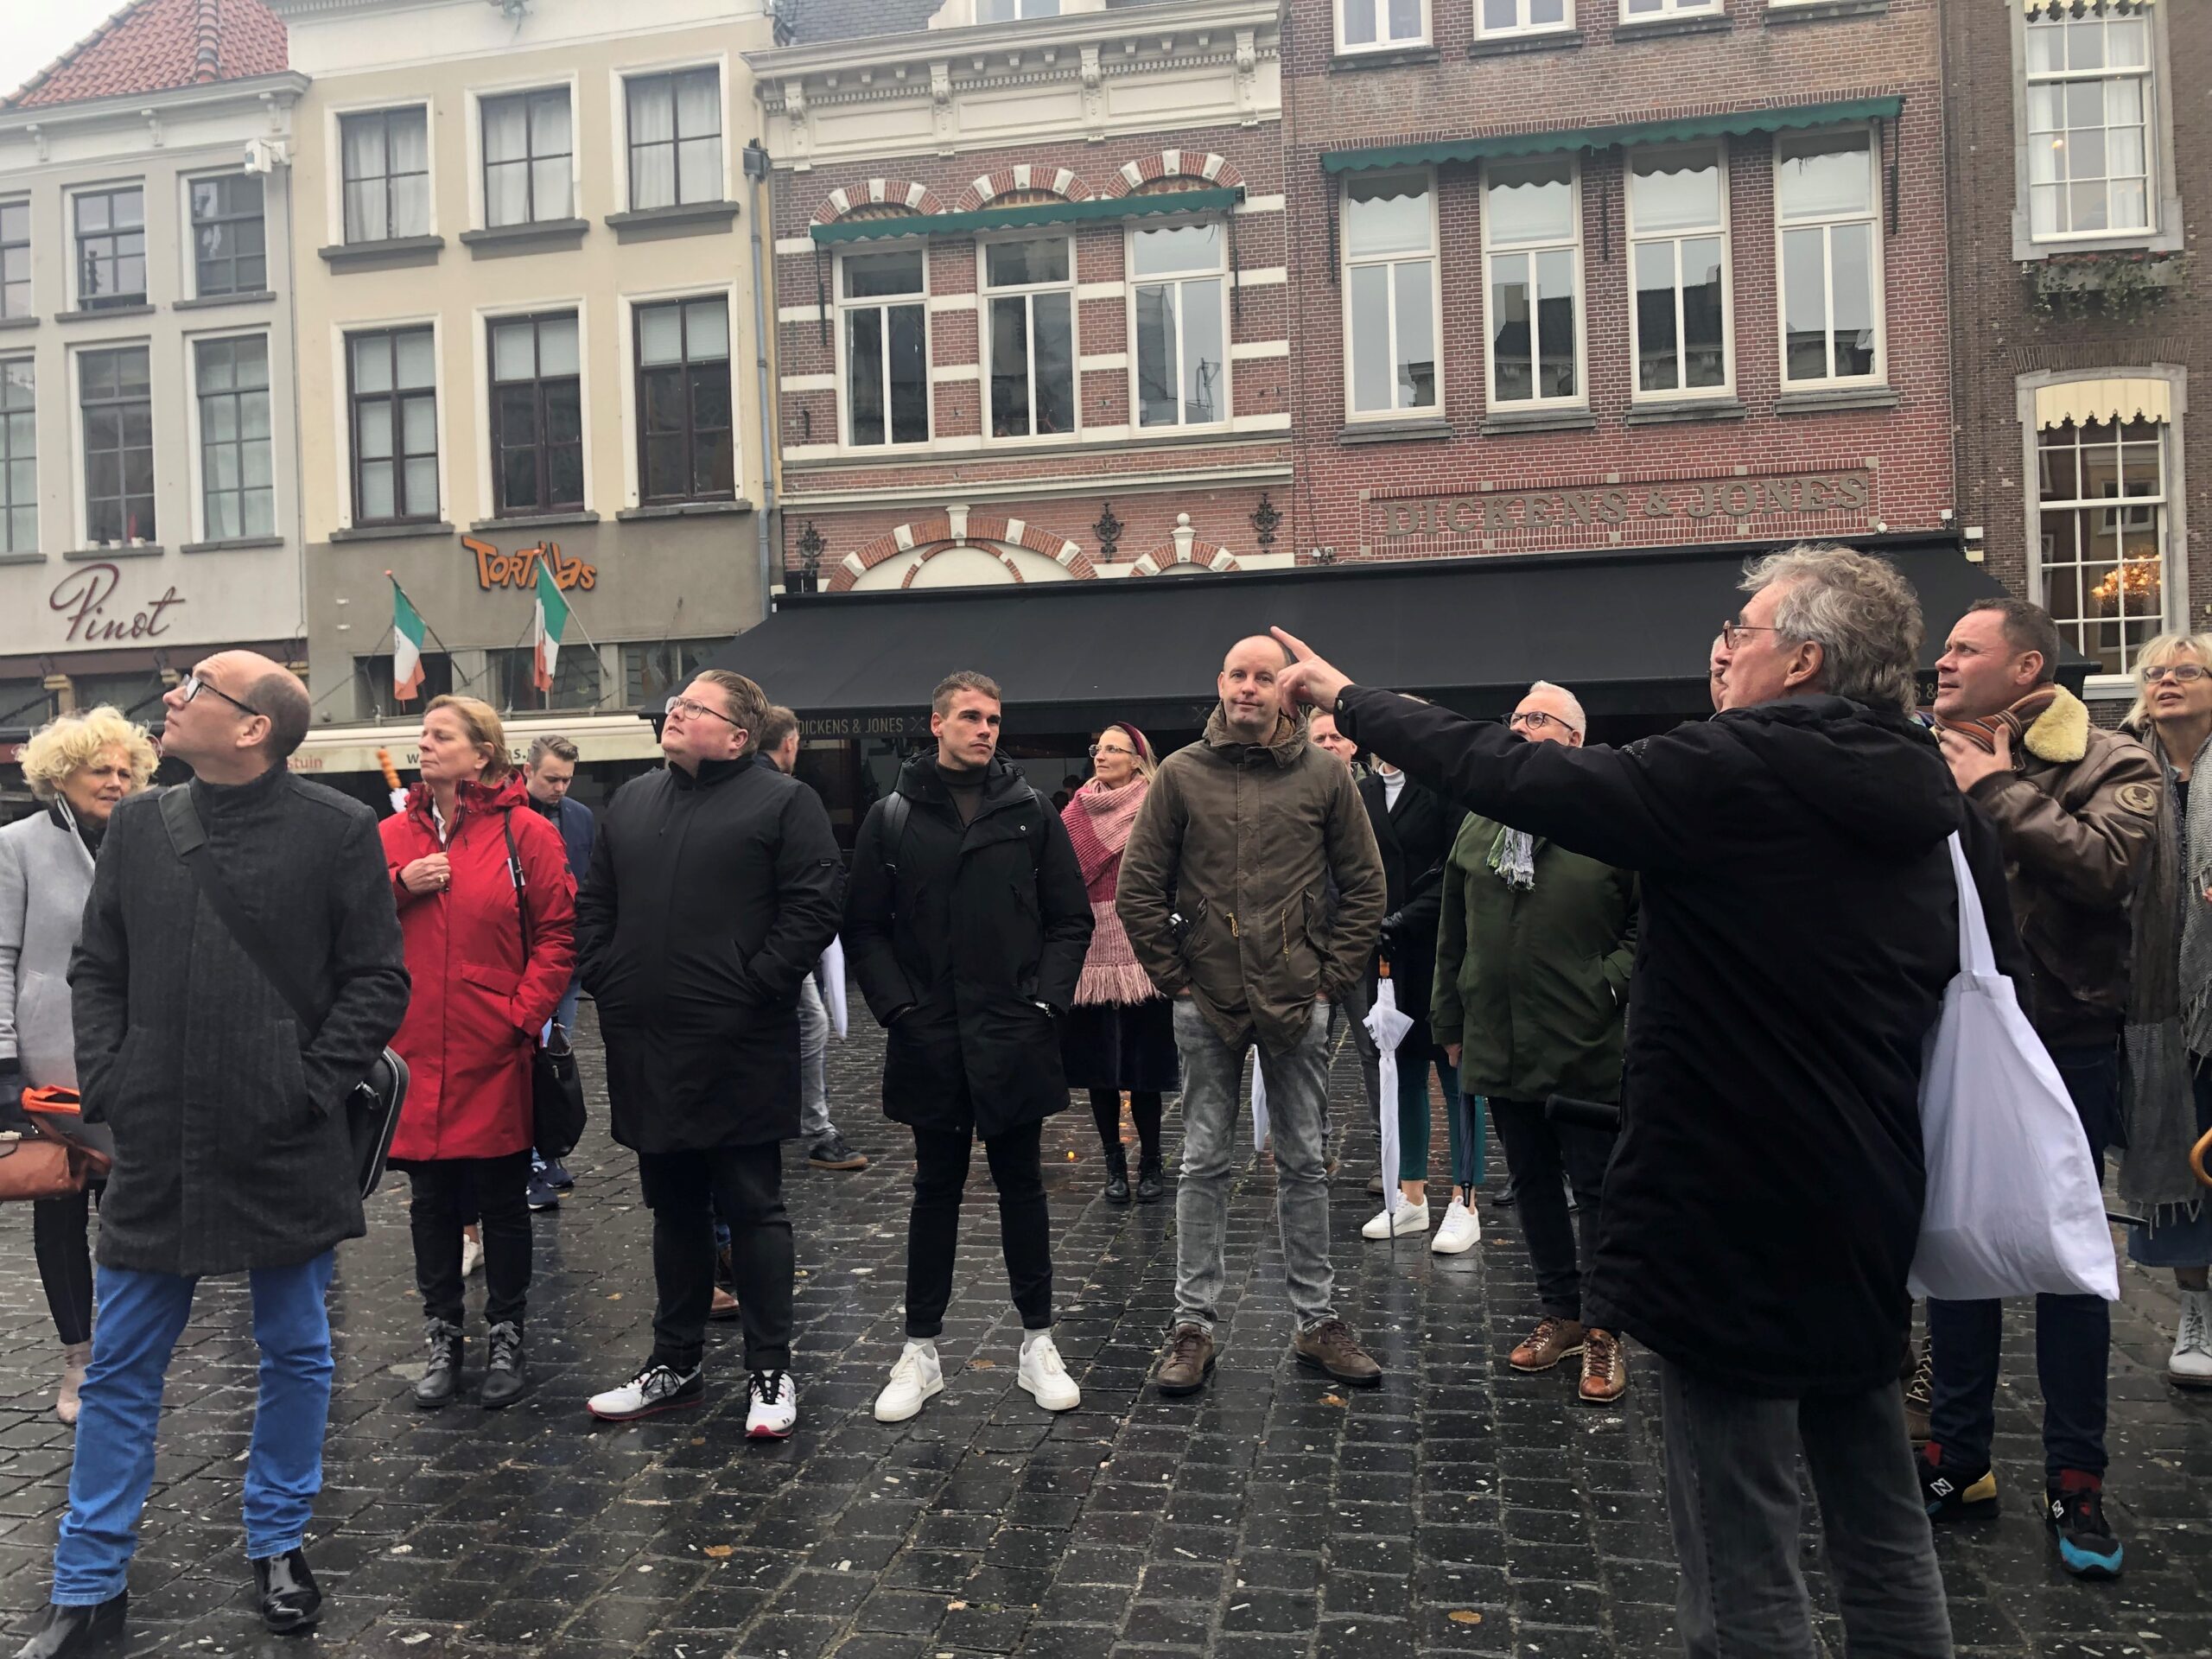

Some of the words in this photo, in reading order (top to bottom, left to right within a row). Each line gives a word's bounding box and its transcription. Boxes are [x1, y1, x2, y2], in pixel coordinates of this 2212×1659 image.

[1383, 490, 1629, 537] DICKENS
[1644, 486, 1674, 517] &
[1687, 474, 1867, 518] JONES
[49, 563, 186, 641] Pinot
[798, 718, 849, 734] DICKENS
[852, 718, 861, 734] &
[865, 717, 904, 733] JONES
